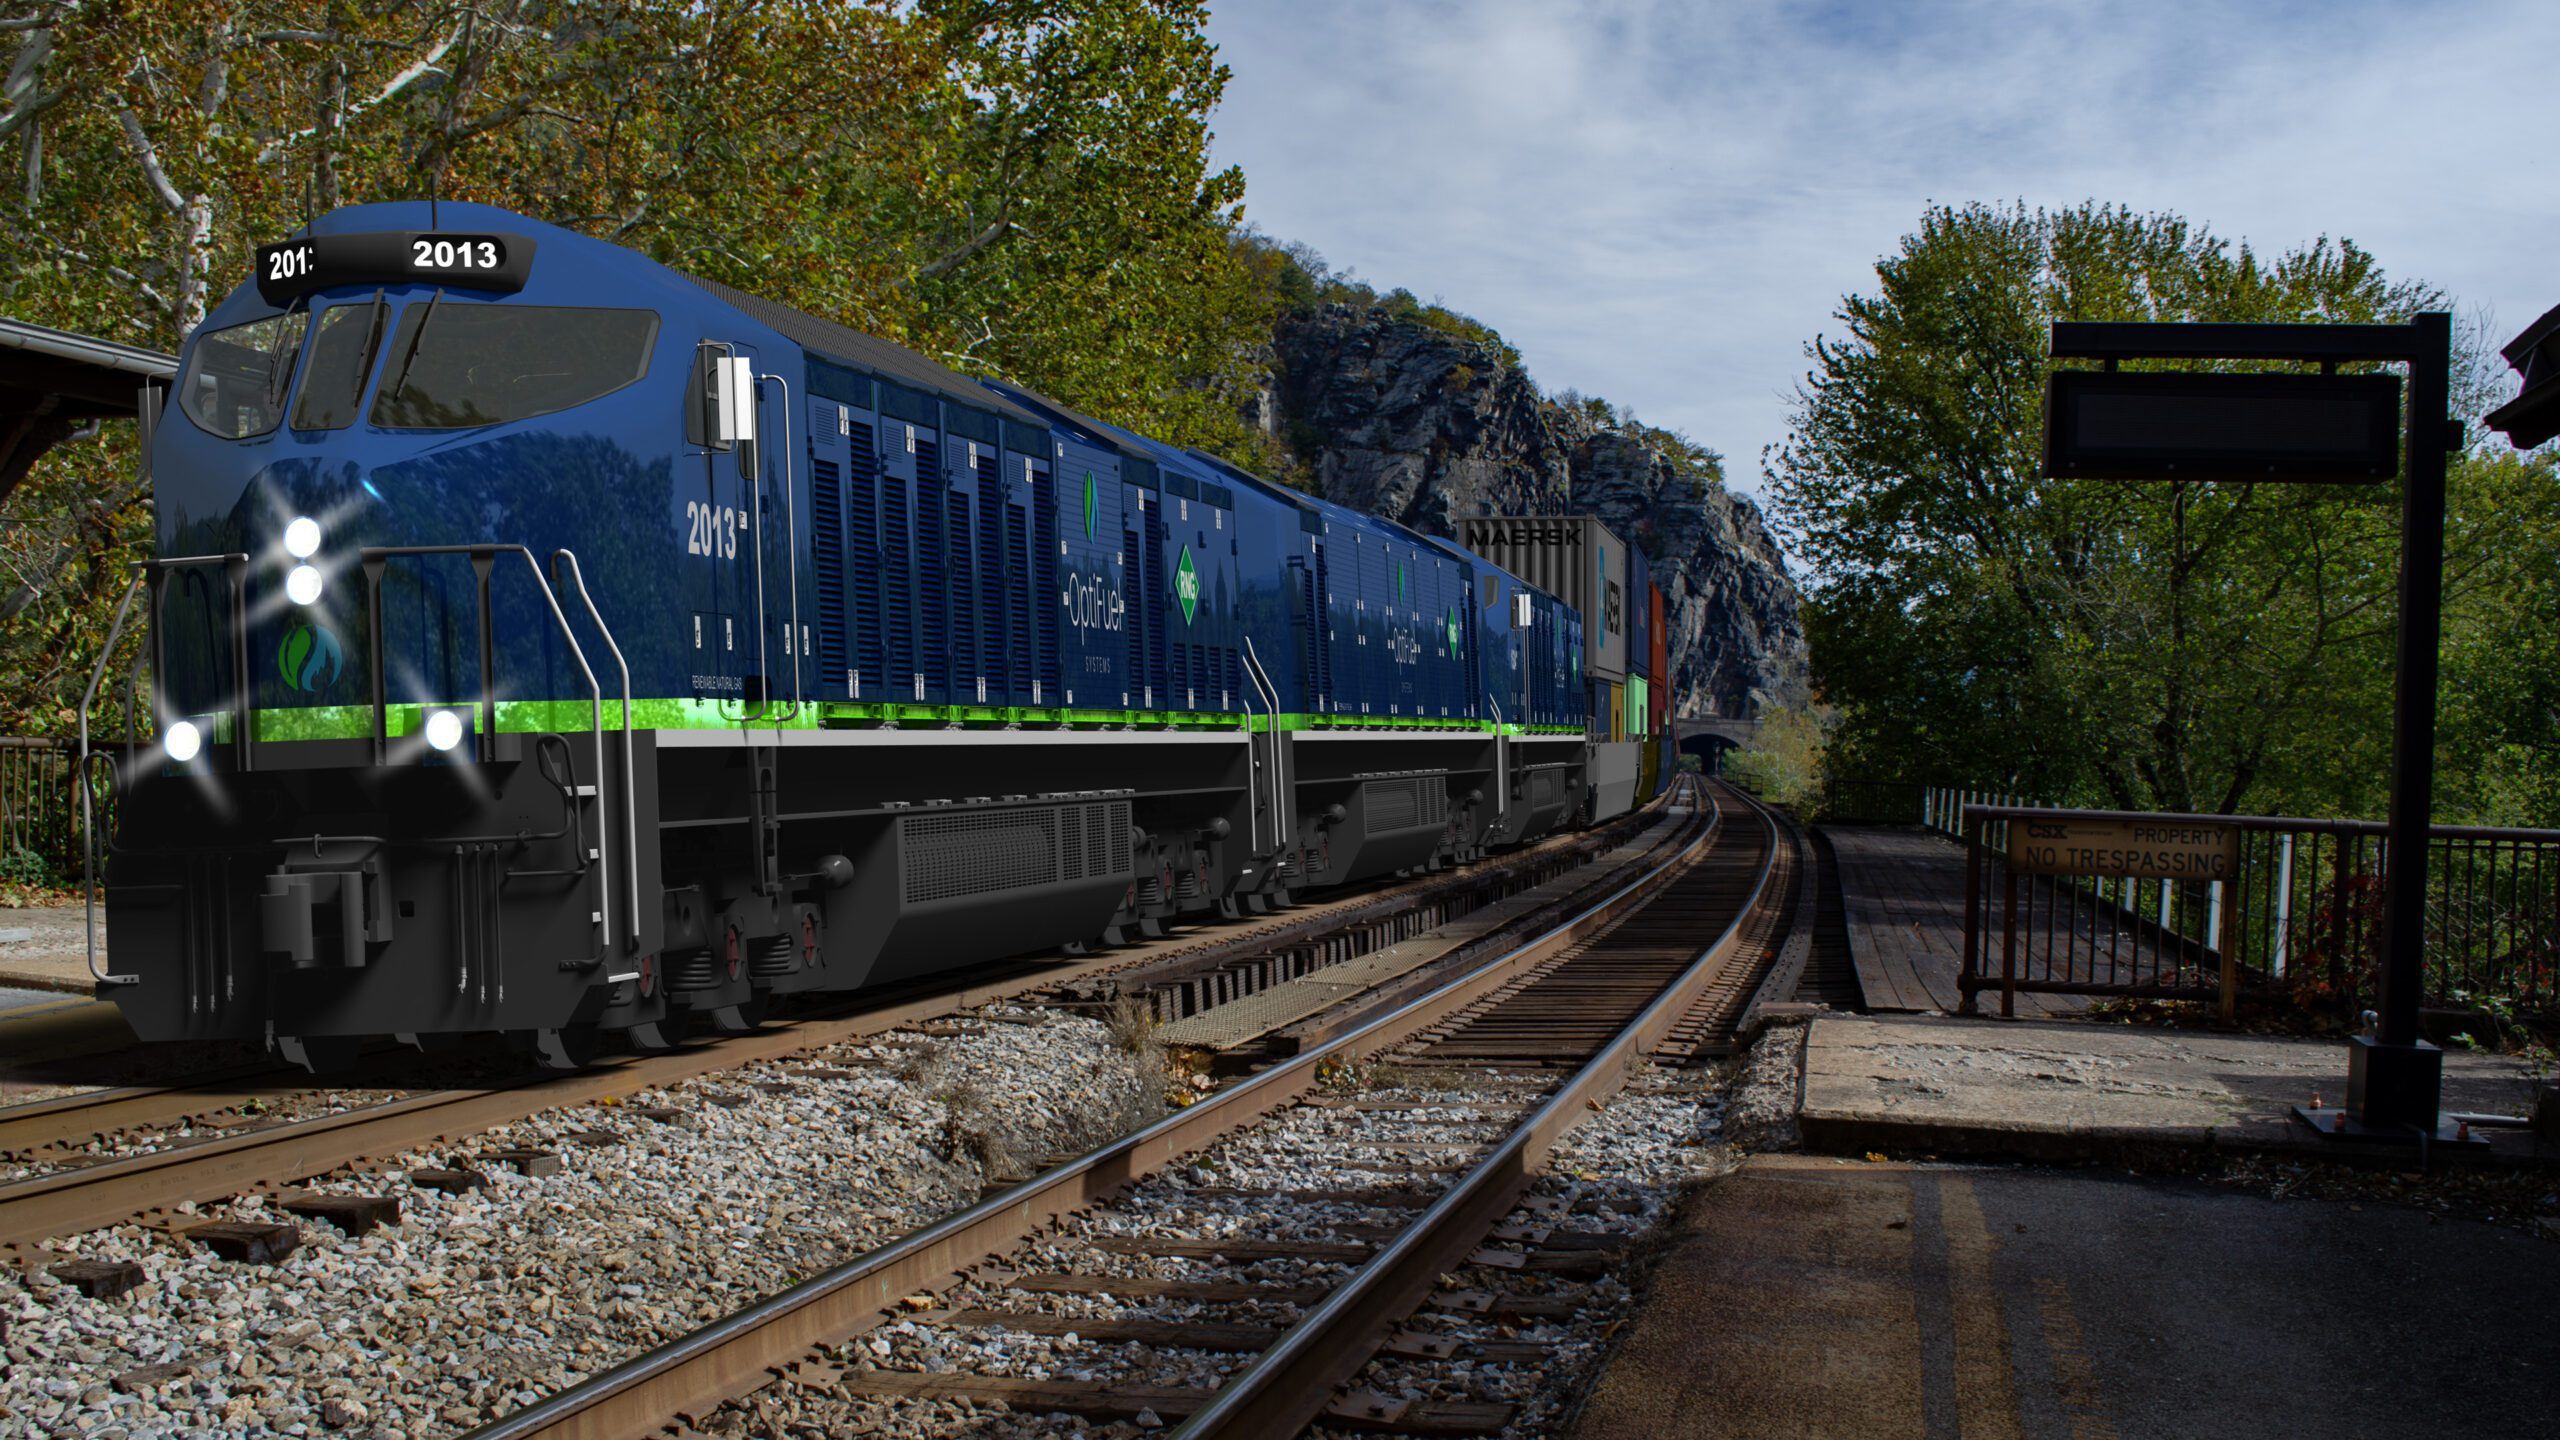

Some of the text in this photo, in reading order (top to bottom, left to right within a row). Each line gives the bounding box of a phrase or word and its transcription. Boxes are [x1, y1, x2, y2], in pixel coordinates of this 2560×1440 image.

[412, 240, 497, 269] 2013
[686, 500, 737, 560] 2013
[1469, 529, 1582, 546] MAERSK
[1179, 570, 1196, 599] RNG
[1068, 571, 1123, 646] OptiFuel
[1084, 655, 1111, 674] SYSTEMS
[2027, 823, 2068, 840] CSX
[2134, 827, 2225, 845] PROPERTY
[2025, 846, 2226, 874] NO TRESPASSING
